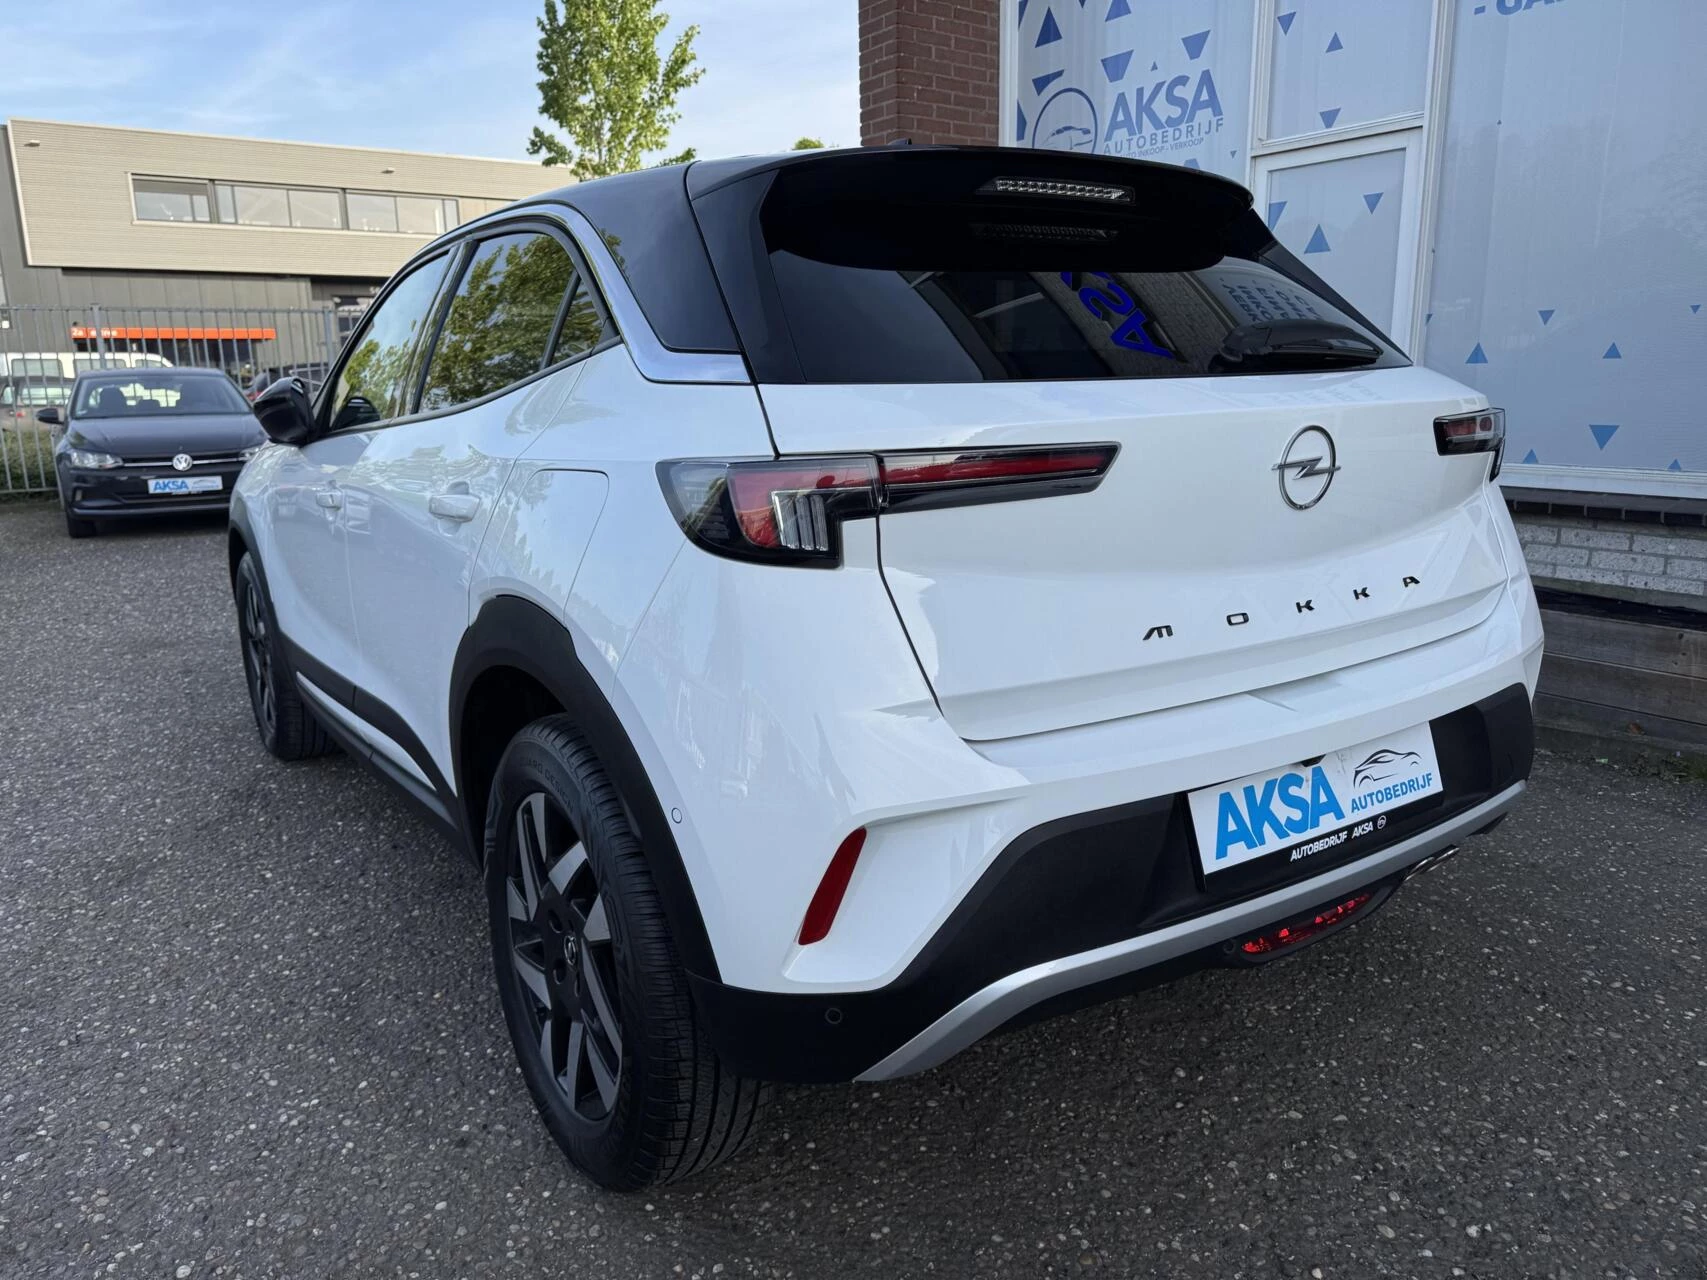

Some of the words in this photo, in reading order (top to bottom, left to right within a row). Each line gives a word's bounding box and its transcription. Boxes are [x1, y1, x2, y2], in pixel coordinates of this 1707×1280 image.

[1104, 69, 1224, 142] AKSA
[1104, 118, 1224, 154] AUTOBEDRIJF
[1170, 137, 1204, 150] VERKOOP
[154, 480, 189, 491] AKSA
[1143, 576, 1420, 640] MOKKA
[1215, 765, 1345, 860] AKSA
[1350, 772, 1432, 814] AUTOBEDRIJF
[1290, 830, 1347, 862] AUTOBEDRIJF
[1351, 821, 1373, 839] AKSA
